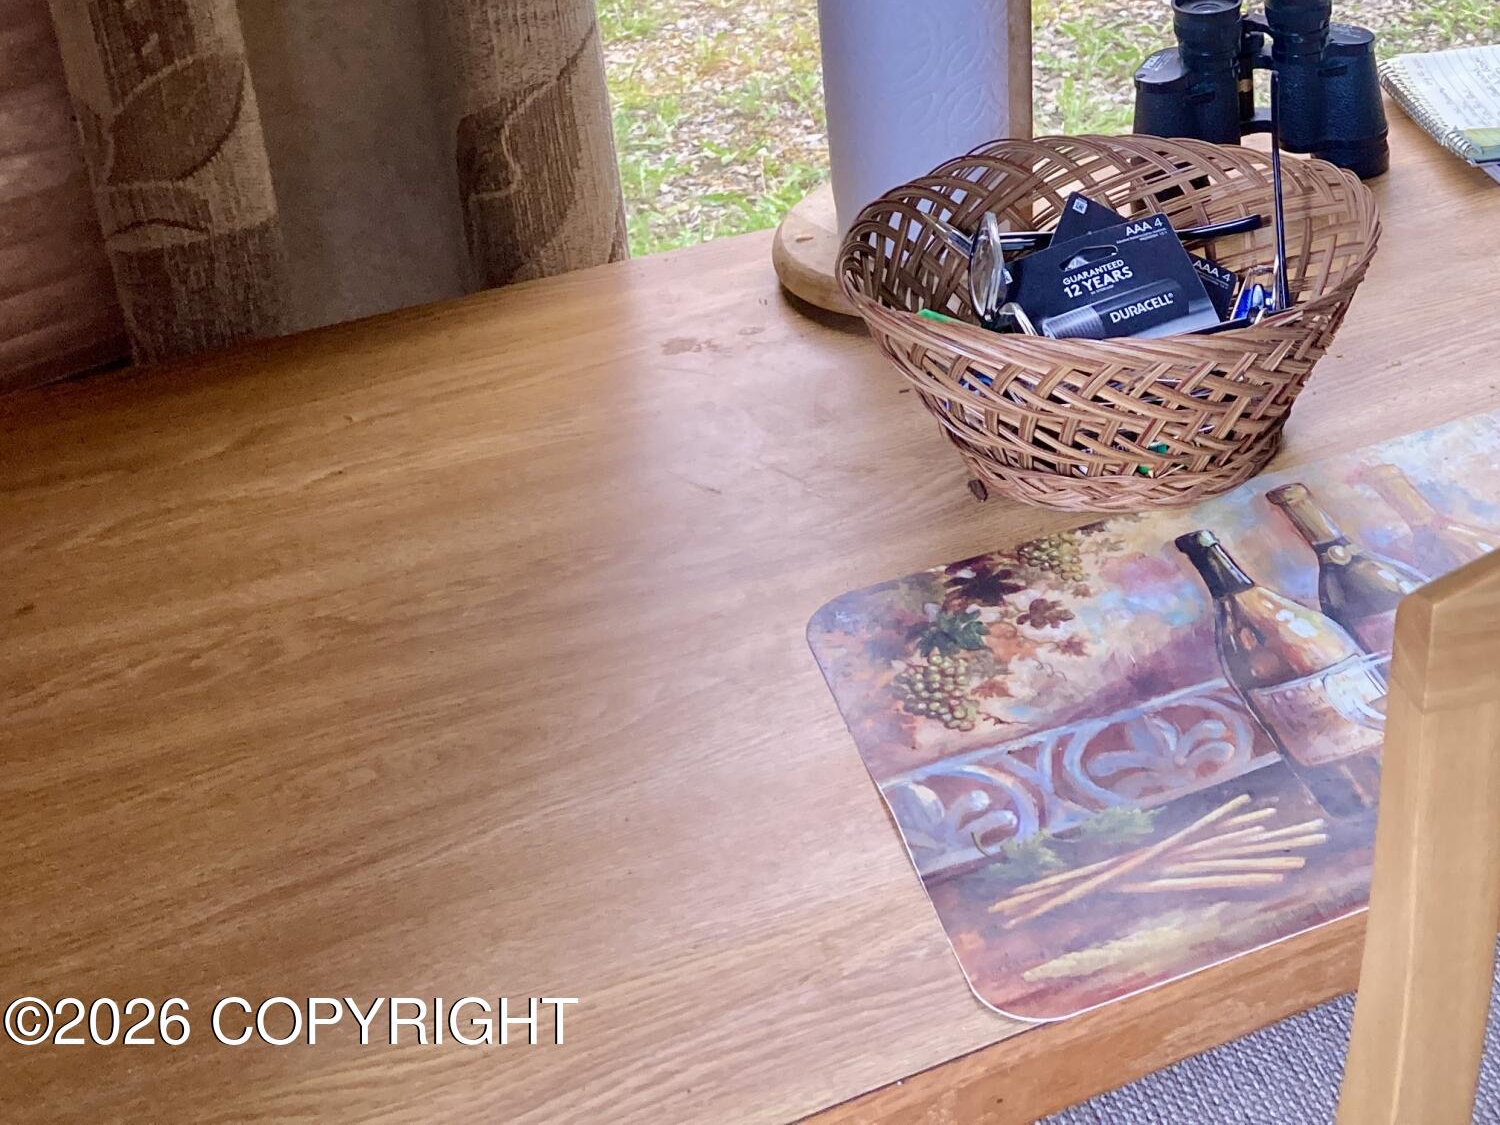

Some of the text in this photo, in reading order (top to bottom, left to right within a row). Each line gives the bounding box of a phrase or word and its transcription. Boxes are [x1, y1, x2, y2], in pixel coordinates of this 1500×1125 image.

[1125, 221, 1153, 236] AAA
[1154, 217, 1163, 228] 4
[1062, 259, 1125, 286] GUARANTEED
[1063, 283, 1083, 299] 12
[1081, 266, 1134, 292] YEARS
[1193, 259, 1220, 278] AAA
[1222, 273, 1232, 283] 4
